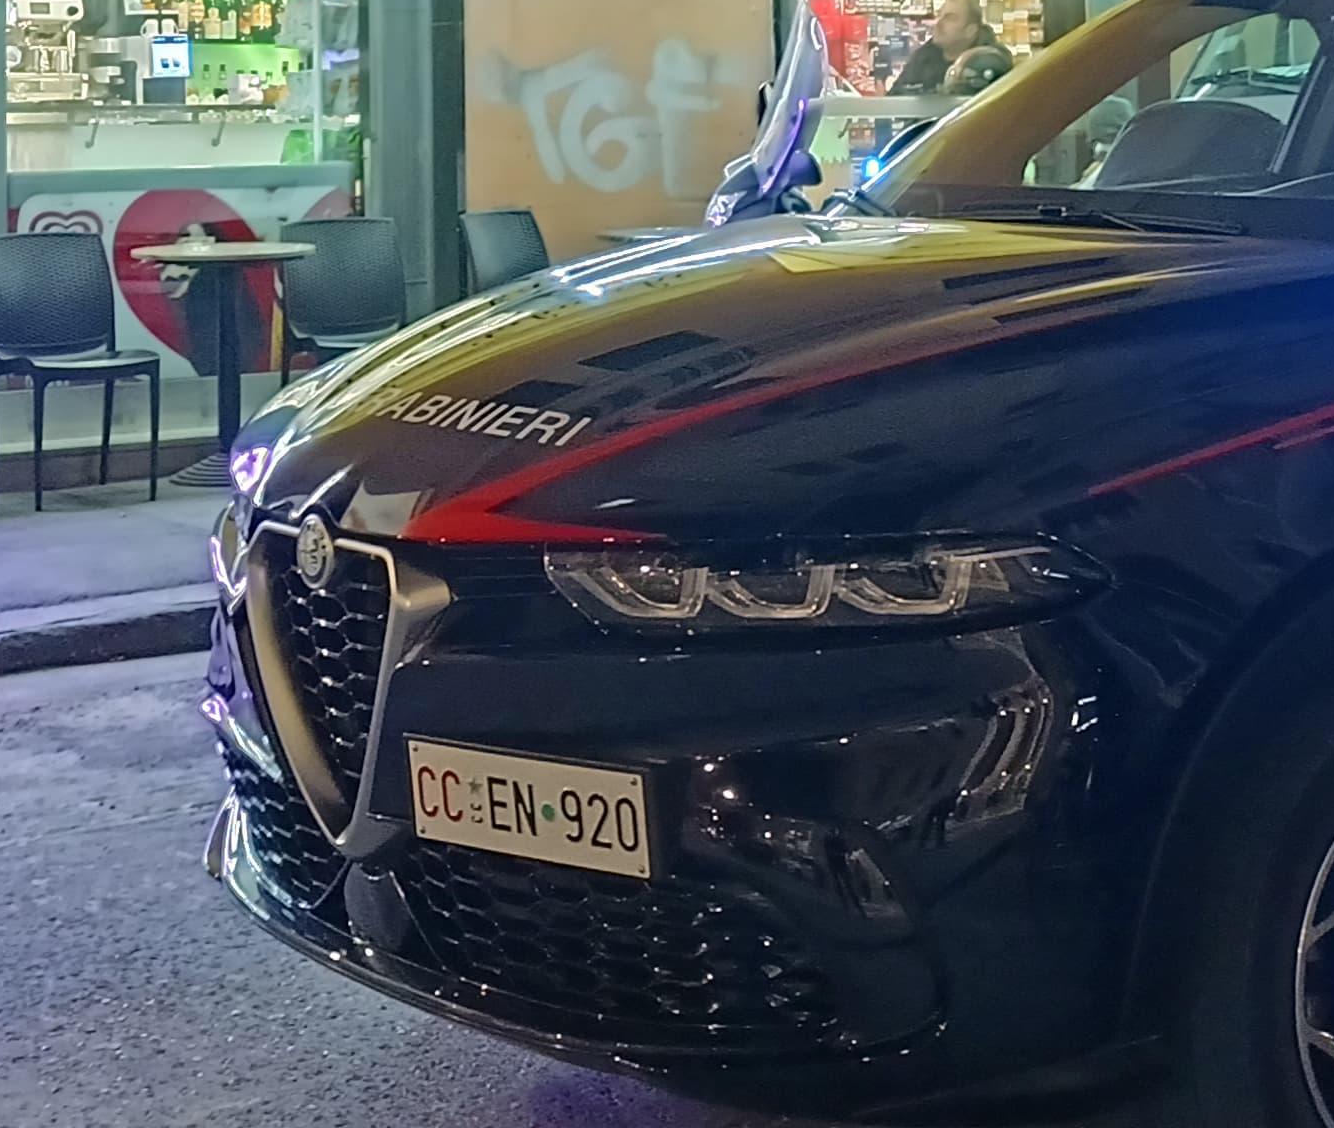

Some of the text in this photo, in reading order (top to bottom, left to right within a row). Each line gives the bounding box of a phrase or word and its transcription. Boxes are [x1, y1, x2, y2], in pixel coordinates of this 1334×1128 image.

[417, 765, 639, 852] CC EN 920
